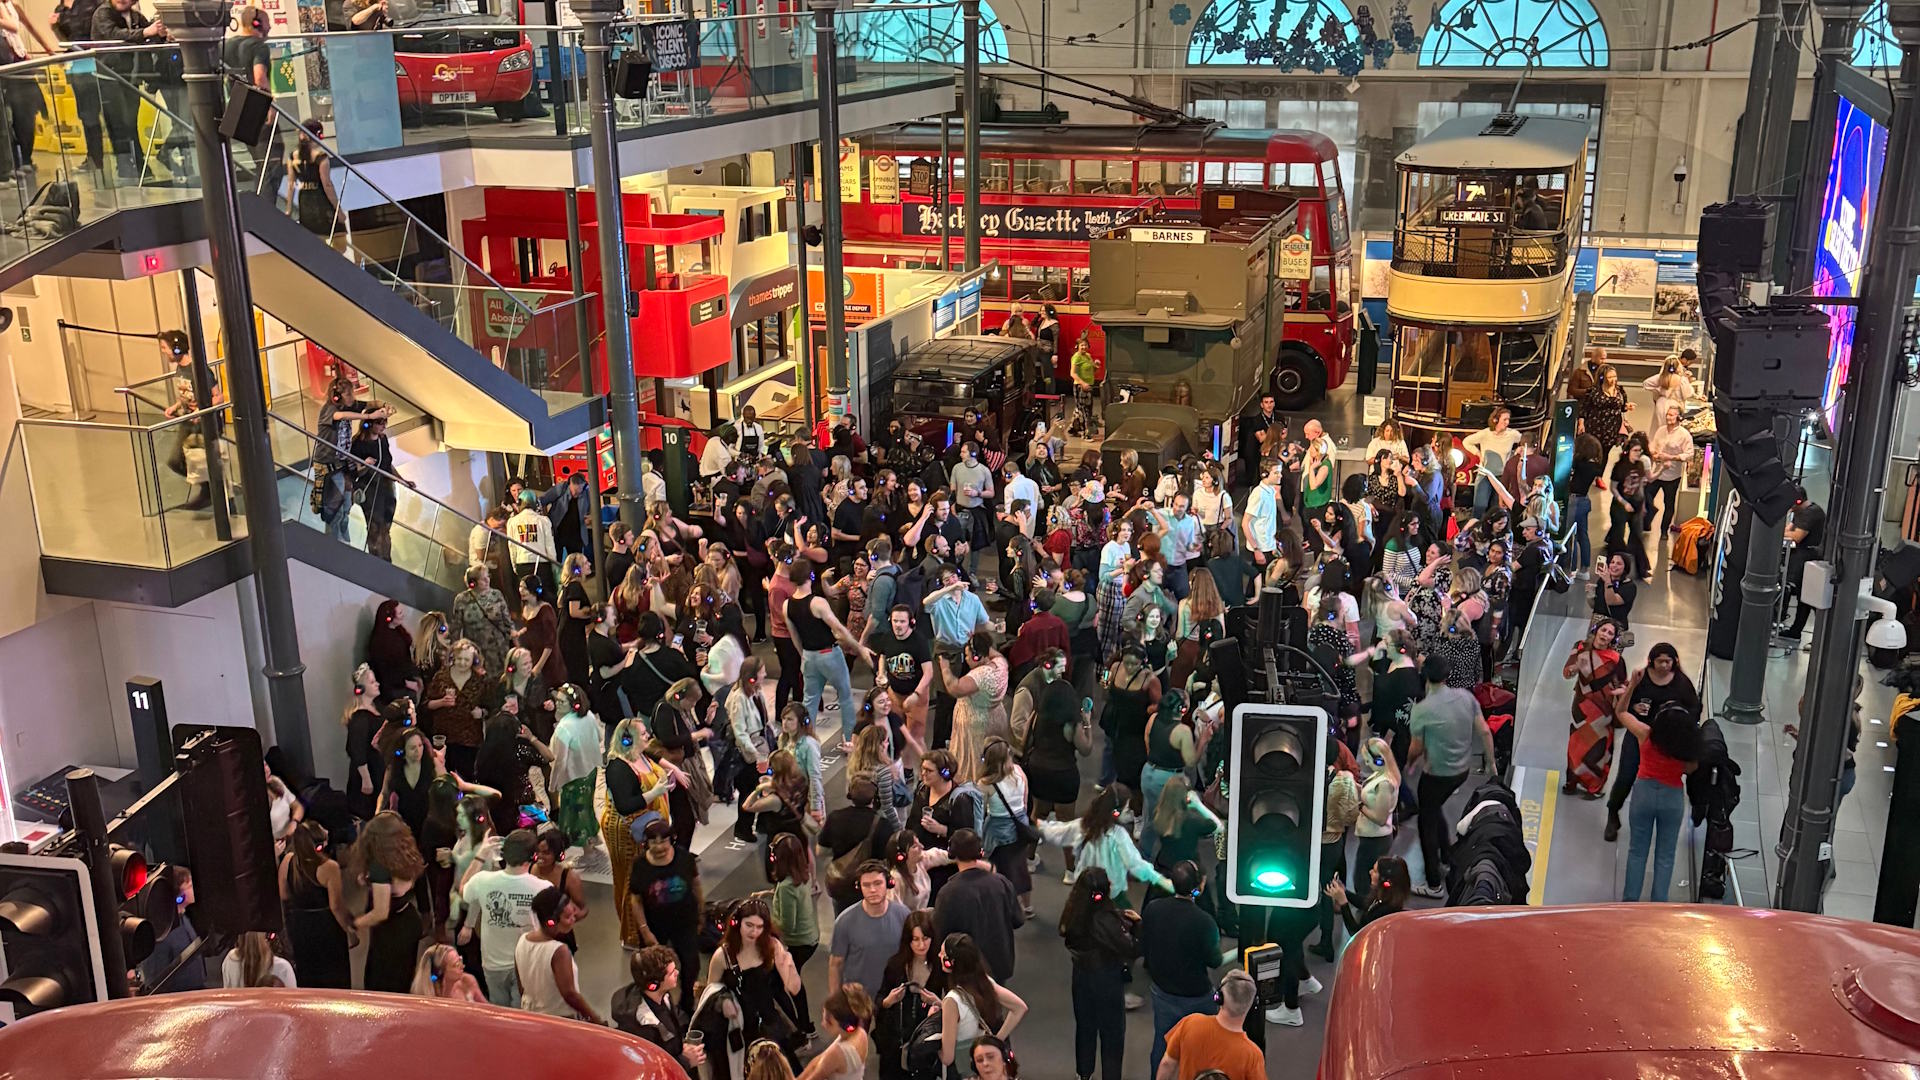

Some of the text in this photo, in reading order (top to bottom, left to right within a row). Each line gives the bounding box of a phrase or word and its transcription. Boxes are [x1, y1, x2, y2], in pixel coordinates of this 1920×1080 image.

[656, 24, 683, 40] ICONIC
[656, 37, 684, 55] SILENT
[658, 53, 687, 68] DISCOS
[439, 93, 470, 103] OPTARE
[912, 171, 929, 183] STOP
[918, 205, 1001, 237] Hackey
[1005, 207, 1082, 233] Gazette
[1152, 231, 1193, 241] BARNES
[1282, 258, 1308, 266] BUSES
[489, 300, 502, 309] All
[490, 312, 524, 324] Aboard
[1564, 406, 1573, 418] 9
[664, 432, 678, 445] 10
[1142, 487, 1150, 496] 6
[132, 690, 149, 710] 11
